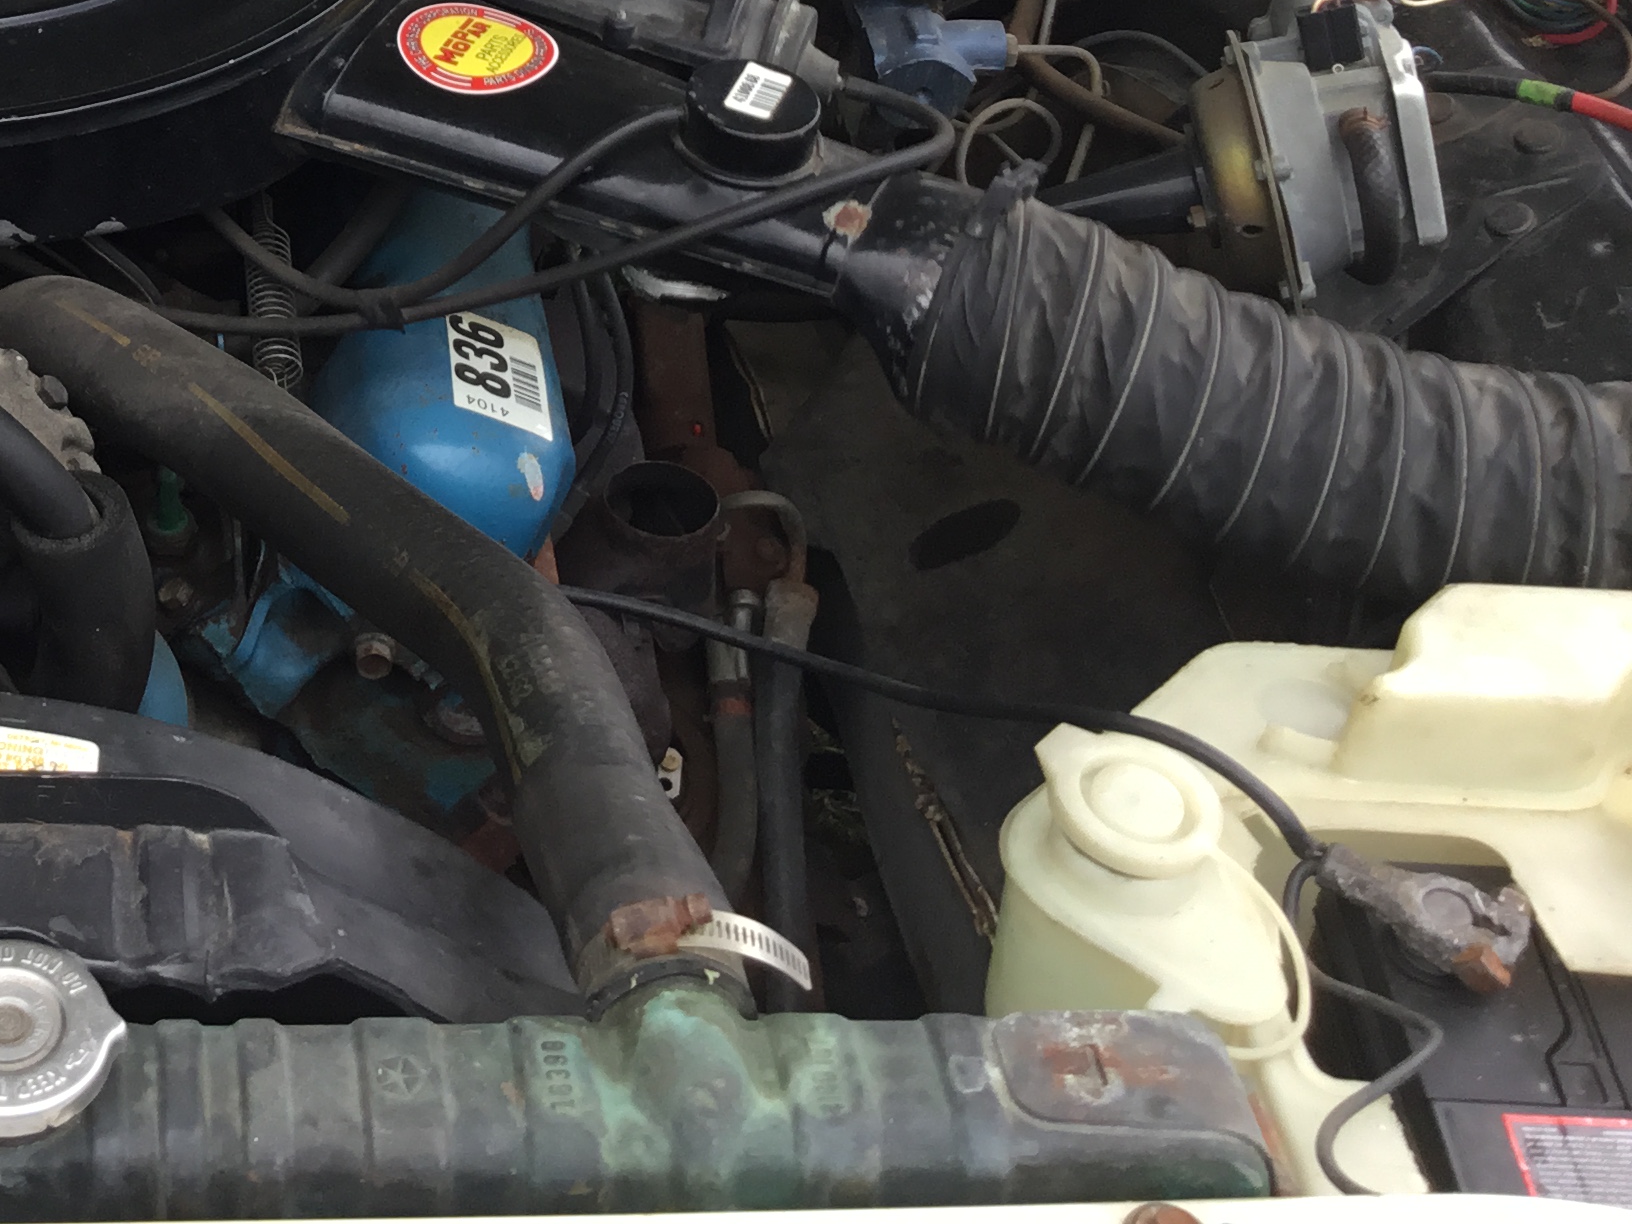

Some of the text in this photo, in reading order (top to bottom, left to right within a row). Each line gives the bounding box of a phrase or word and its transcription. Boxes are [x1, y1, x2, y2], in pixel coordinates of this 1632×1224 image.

[475, 34, 509, 61] PARTS
[448, 314, 512, 399] 836
[466, 393, 510, 418] 4104
